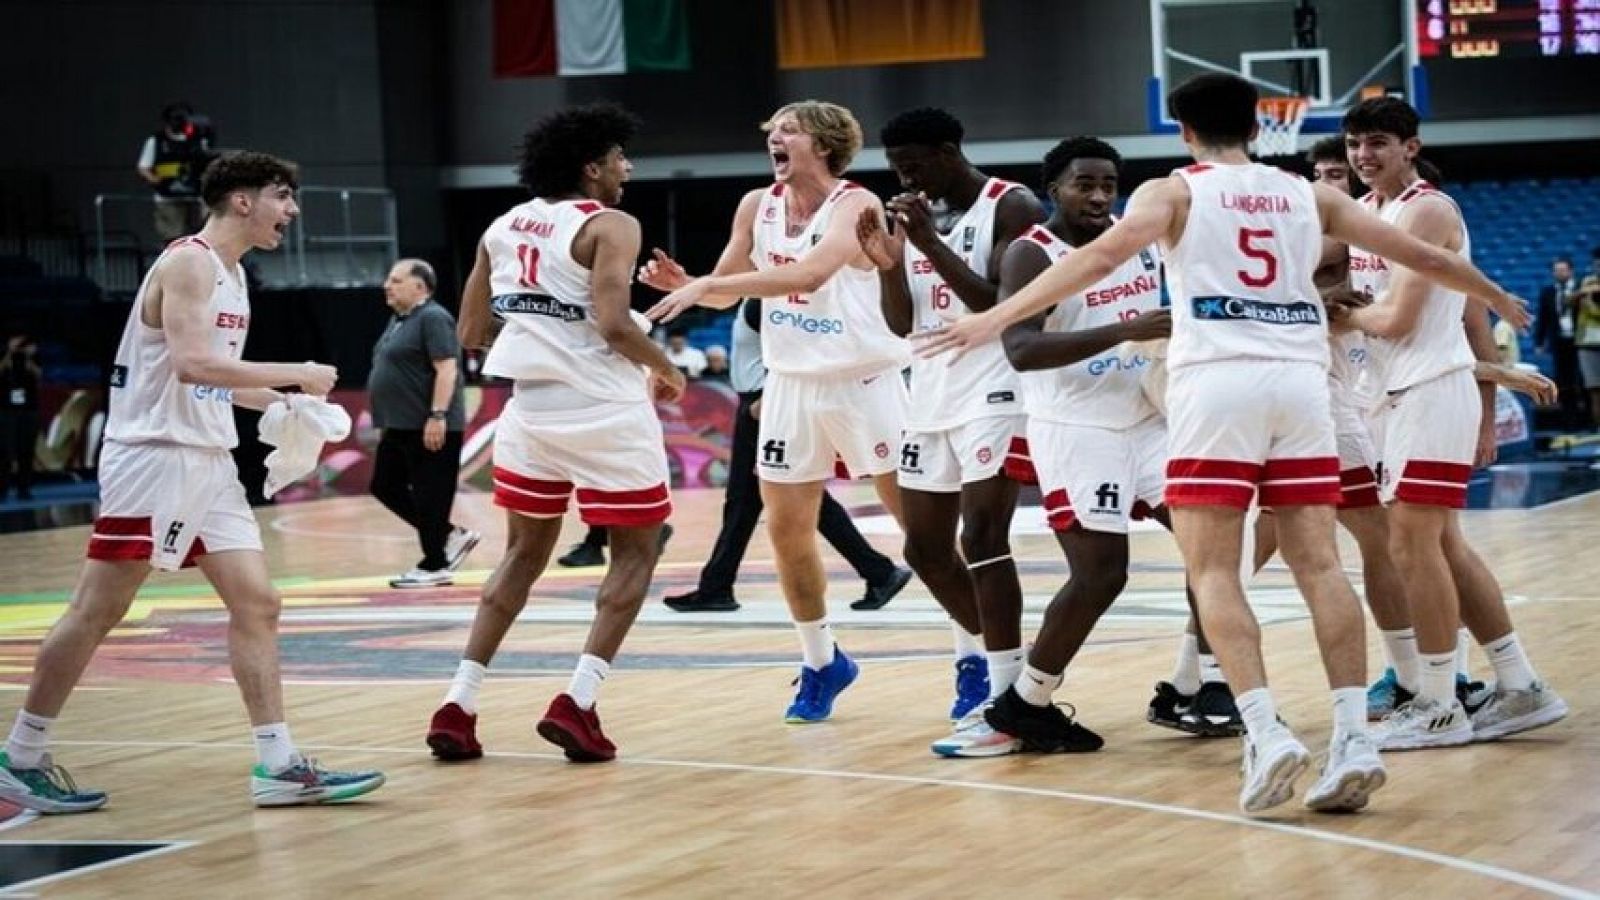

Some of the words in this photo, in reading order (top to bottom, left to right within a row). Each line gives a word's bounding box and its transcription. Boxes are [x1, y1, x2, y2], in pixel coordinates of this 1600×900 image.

[517, 242, 541, 288] 11
[1237, 226, 1277, 288] 5
[931, 283, 950, 310] 16
[1224, 299, 1318, 323] CaixaBank
[763, 440, 786, 463] fi
[902, 443, 920, 467] fi
[1095, 483, 1118, 509] fi
